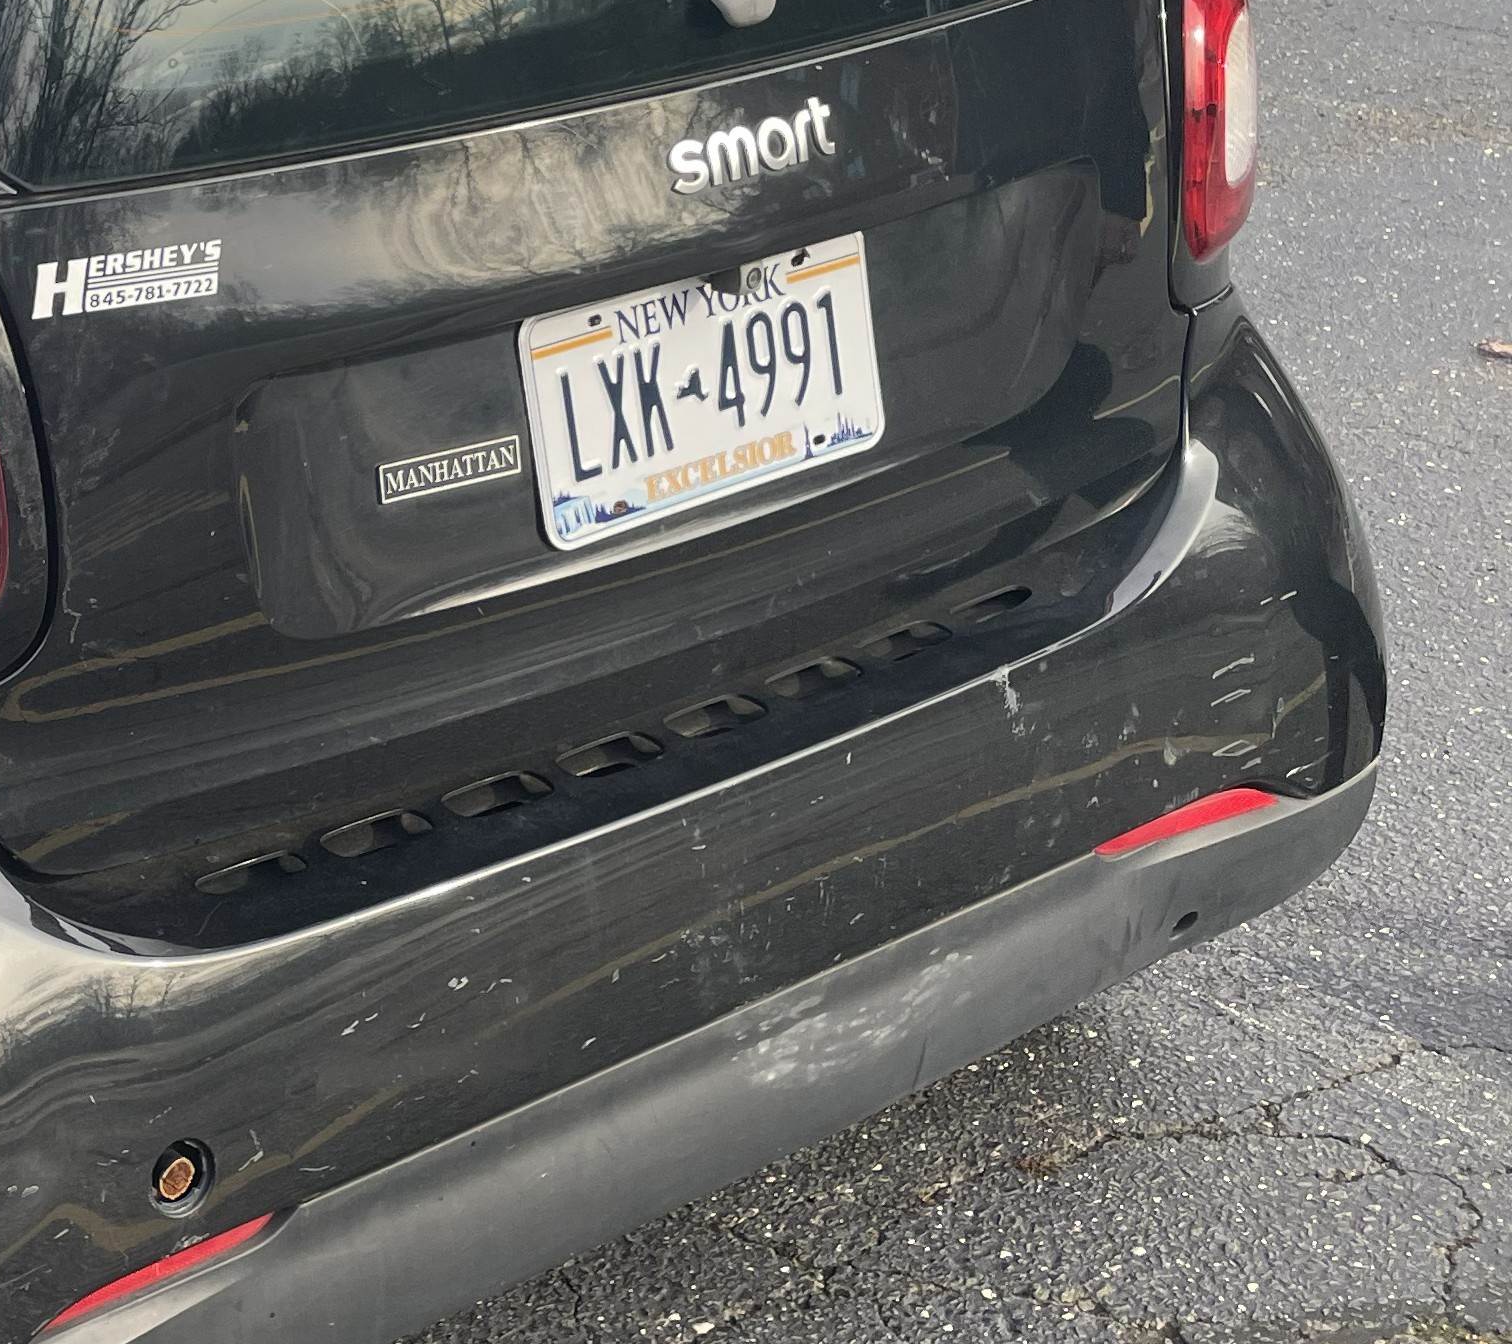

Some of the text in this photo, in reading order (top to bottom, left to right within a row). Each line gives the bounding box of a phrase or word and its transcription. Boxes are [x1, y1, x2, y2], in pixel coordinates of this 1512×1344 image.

[667, 96, 835, 195] smart
[32, 239, 221, 320] HERSHEY'S
[90, 277, 214, 308] 845-781-7722
[614, 288, 690, 345] NEW
[555, 287, 844, 484] LXK 4991
[385, 444, 515, 495] MANHATTAN
[644, 429, 797, 503] EXCELSIOR
